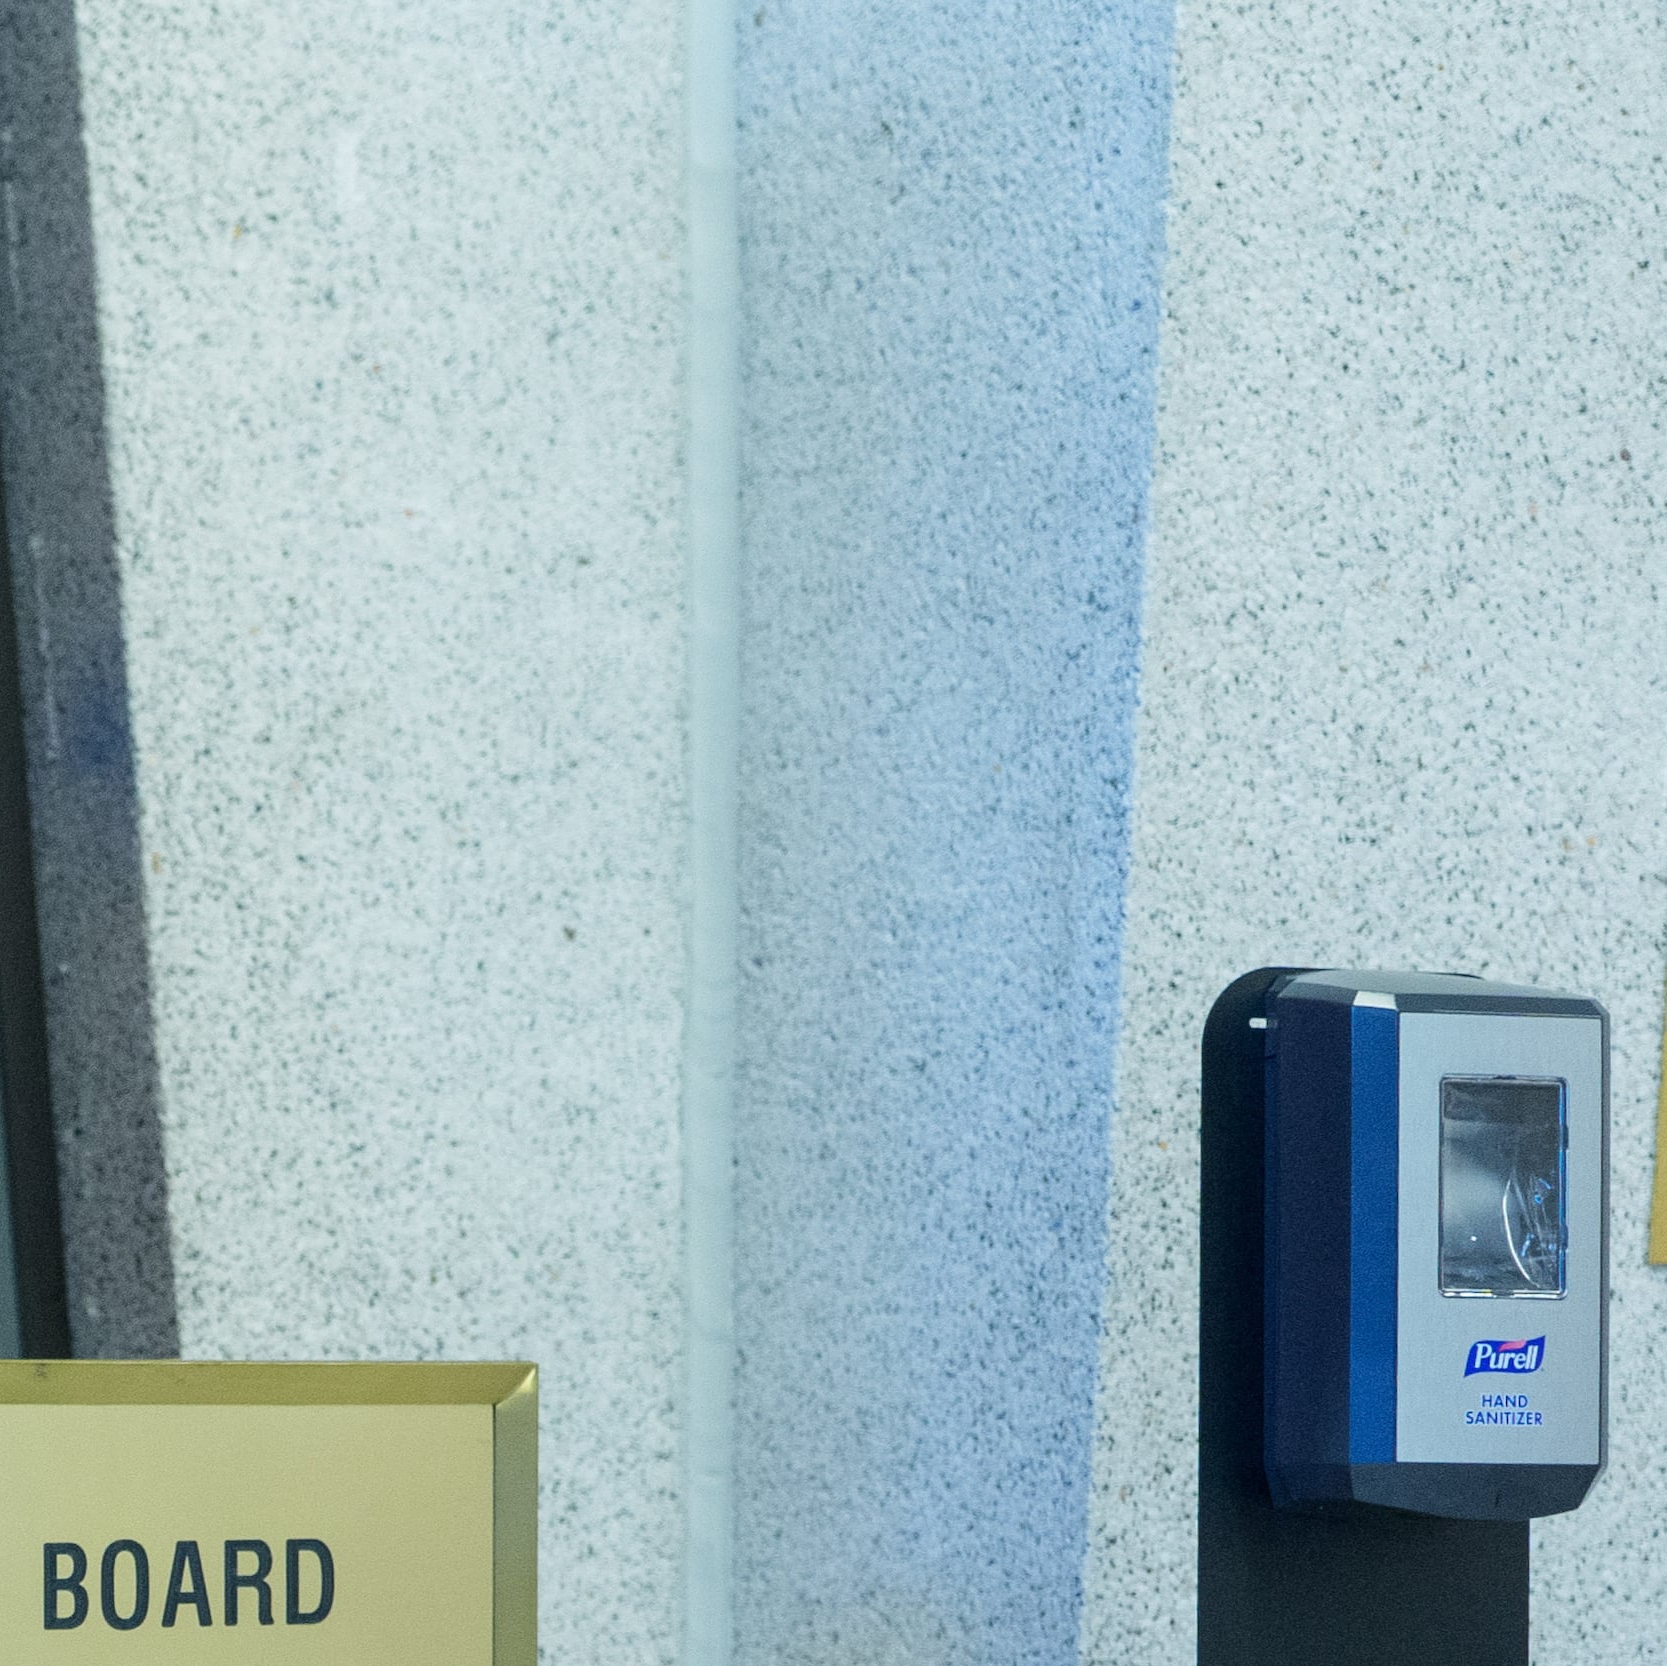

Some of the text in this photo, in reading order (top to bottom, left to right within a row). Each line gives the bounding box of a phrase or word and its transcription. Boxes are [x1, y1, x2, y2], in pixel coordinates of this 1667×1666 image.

[1474, 1343, 1539, 1370] Purell
[1481, 1394, 1529, 1408] HAND
[1465, 1411, 1543, 1425] SANITIZER
[43, 1538, 335, 1631] BOARD
